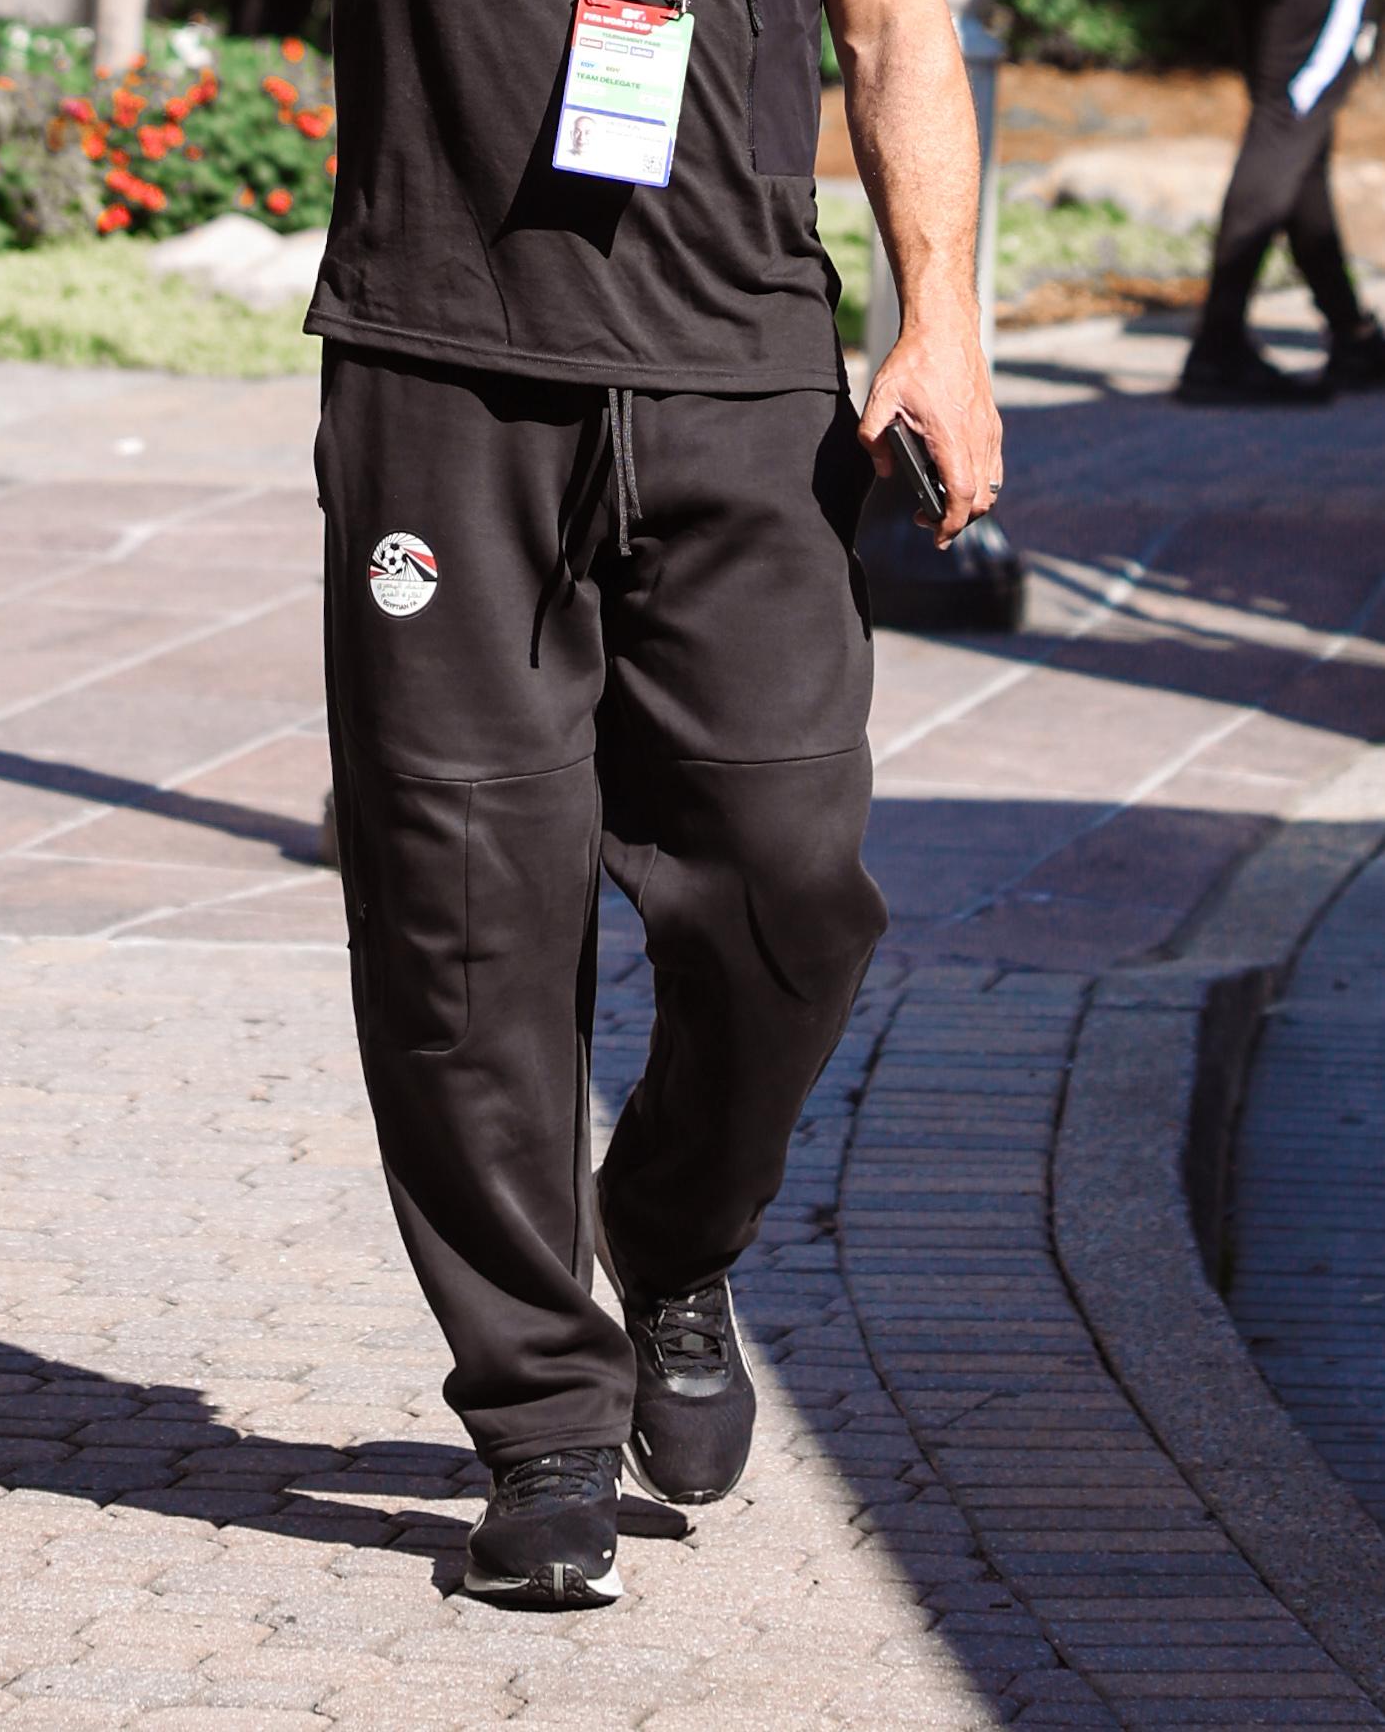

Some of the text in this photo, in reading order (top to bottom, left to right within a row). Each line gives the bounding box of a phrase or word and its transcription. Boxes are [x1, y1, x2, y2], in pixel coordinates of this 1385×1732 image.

[633, 21, 652, 31] CUP
[577, 72, 642, 89] TEAM DELEGATE
